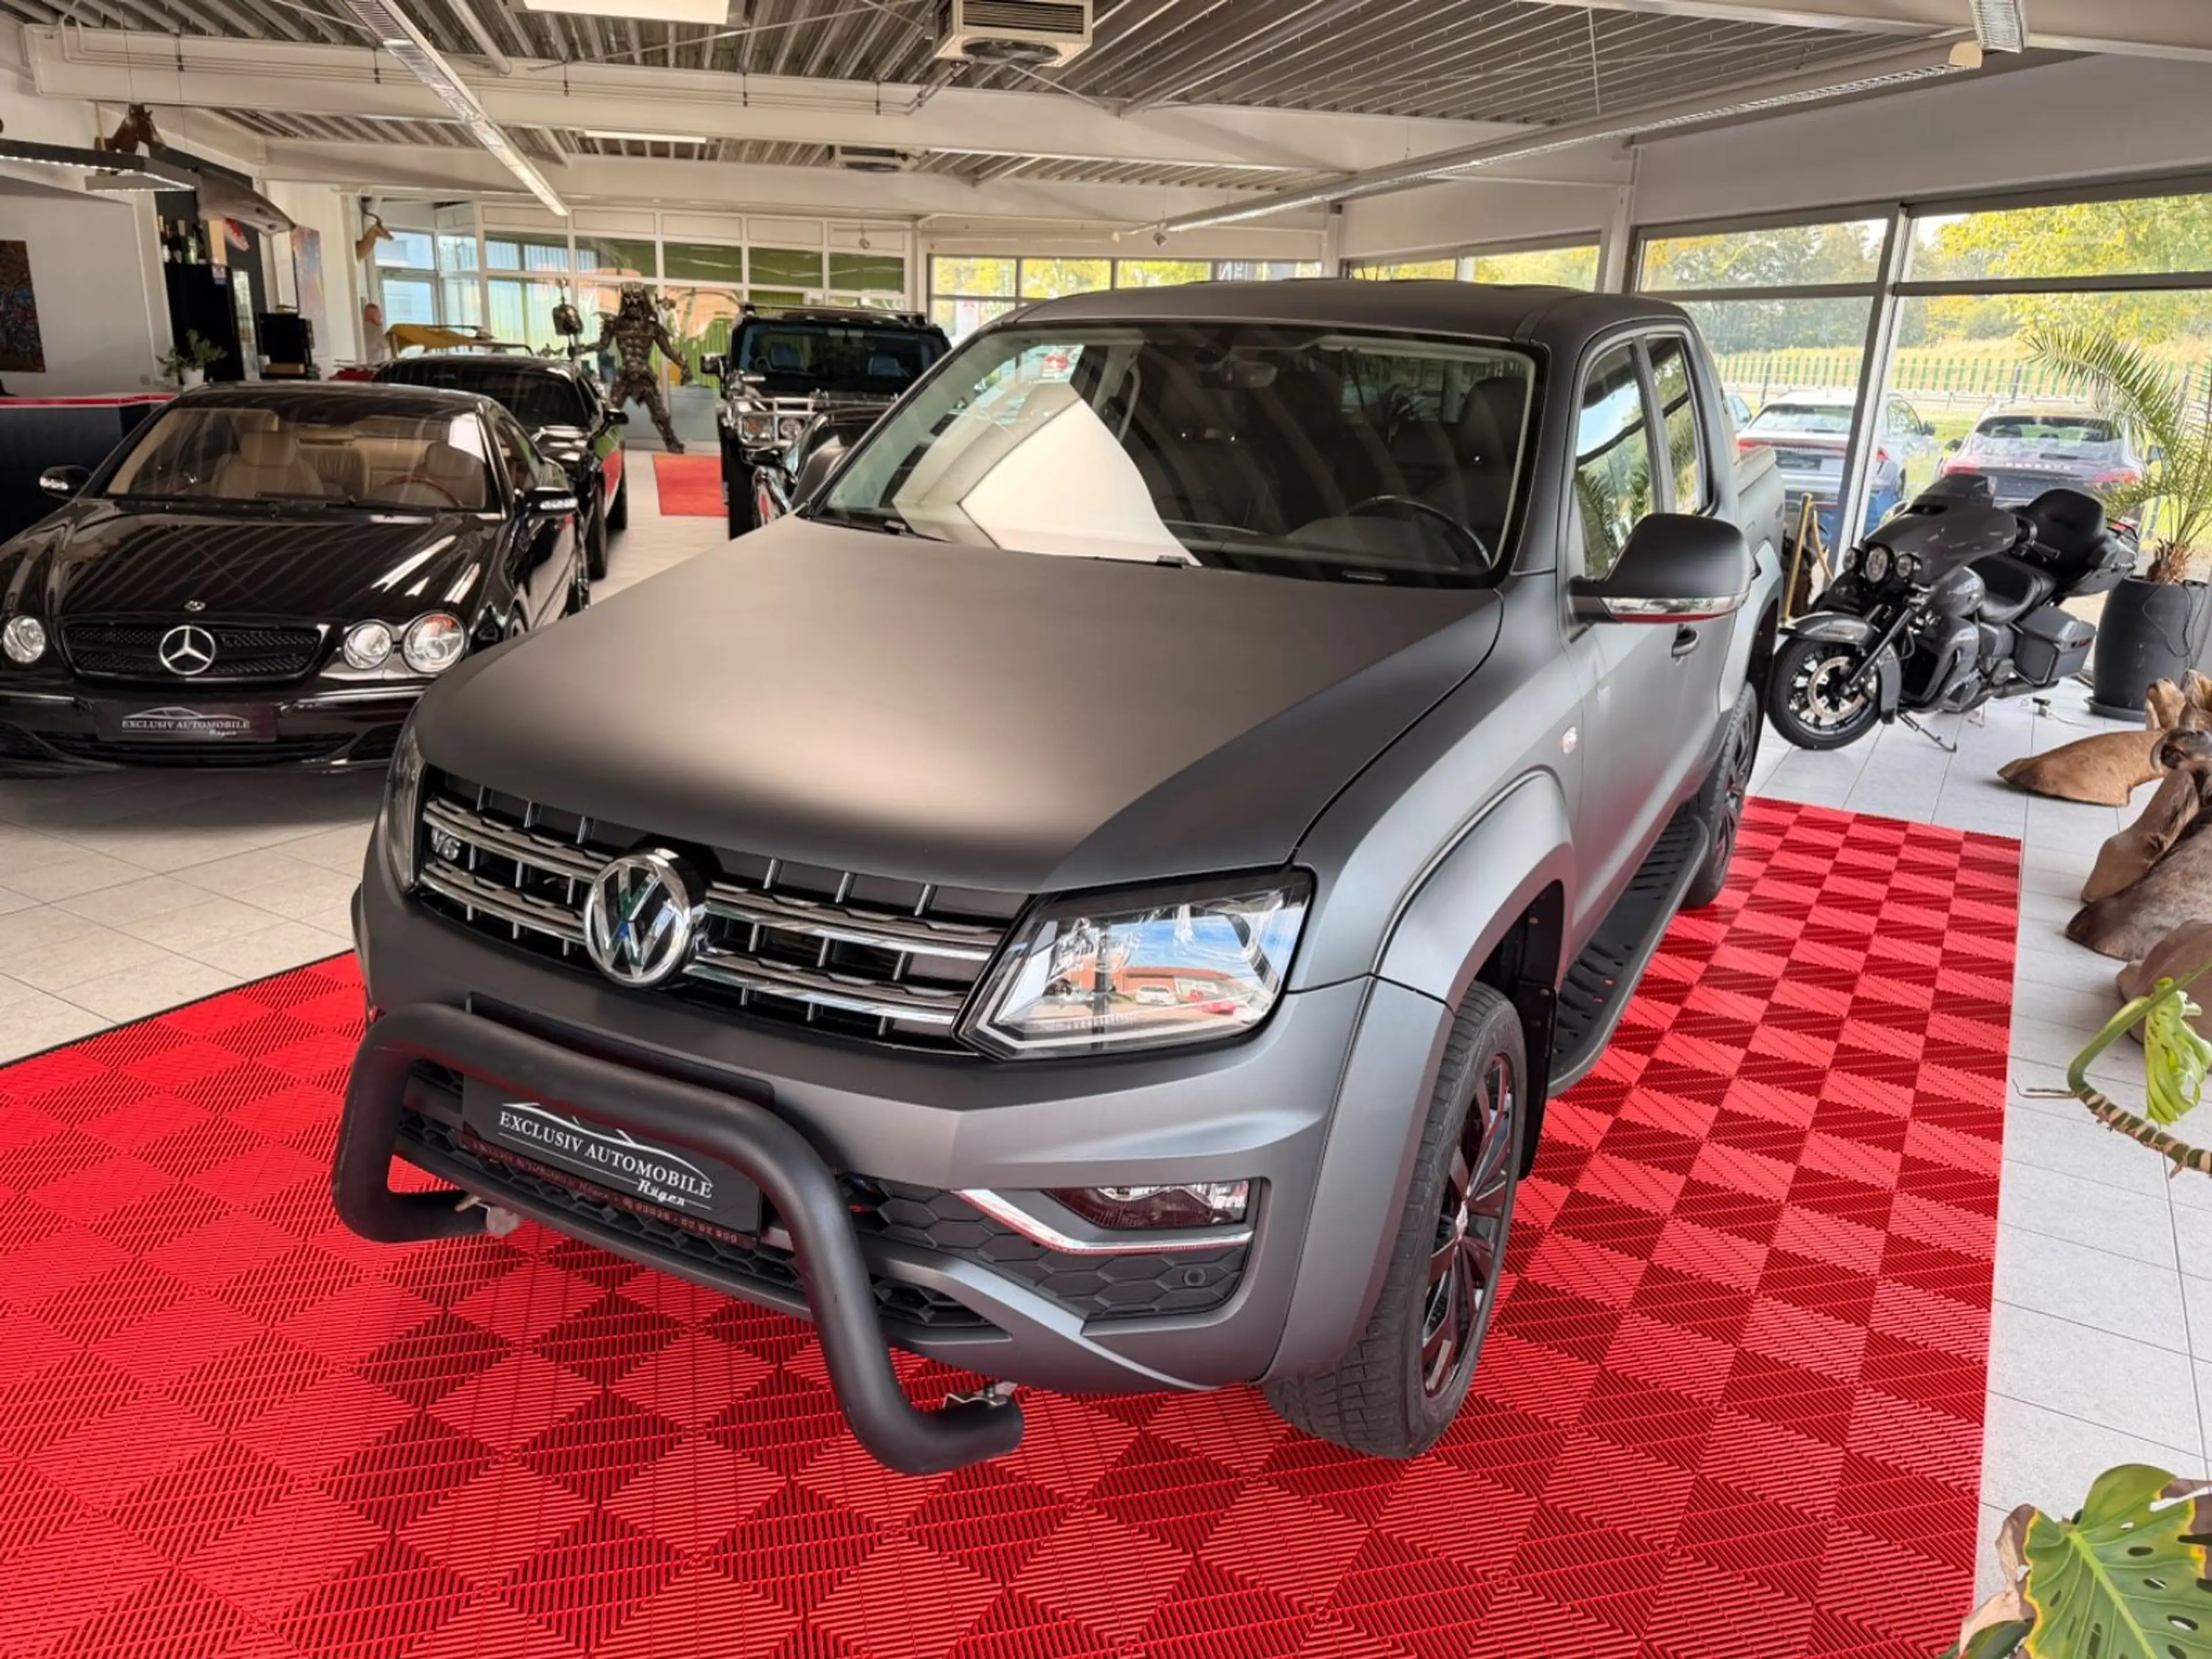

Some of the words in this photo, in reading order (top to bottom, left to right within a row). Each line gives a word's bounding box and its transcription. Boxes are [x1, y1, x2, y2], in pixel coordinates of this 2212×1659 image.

[122, 720, 173, 729] EXCLUSIV
[176, 720, 250, 729] AUTOMOBILE
[432, 828, 461, 861] V6
[499, 1111, 585, 1152] EXCLUSIV
[584, 1142, 714, 1199] AUTOMOBILE
[637, 1179, 685, 1207] Rügen
